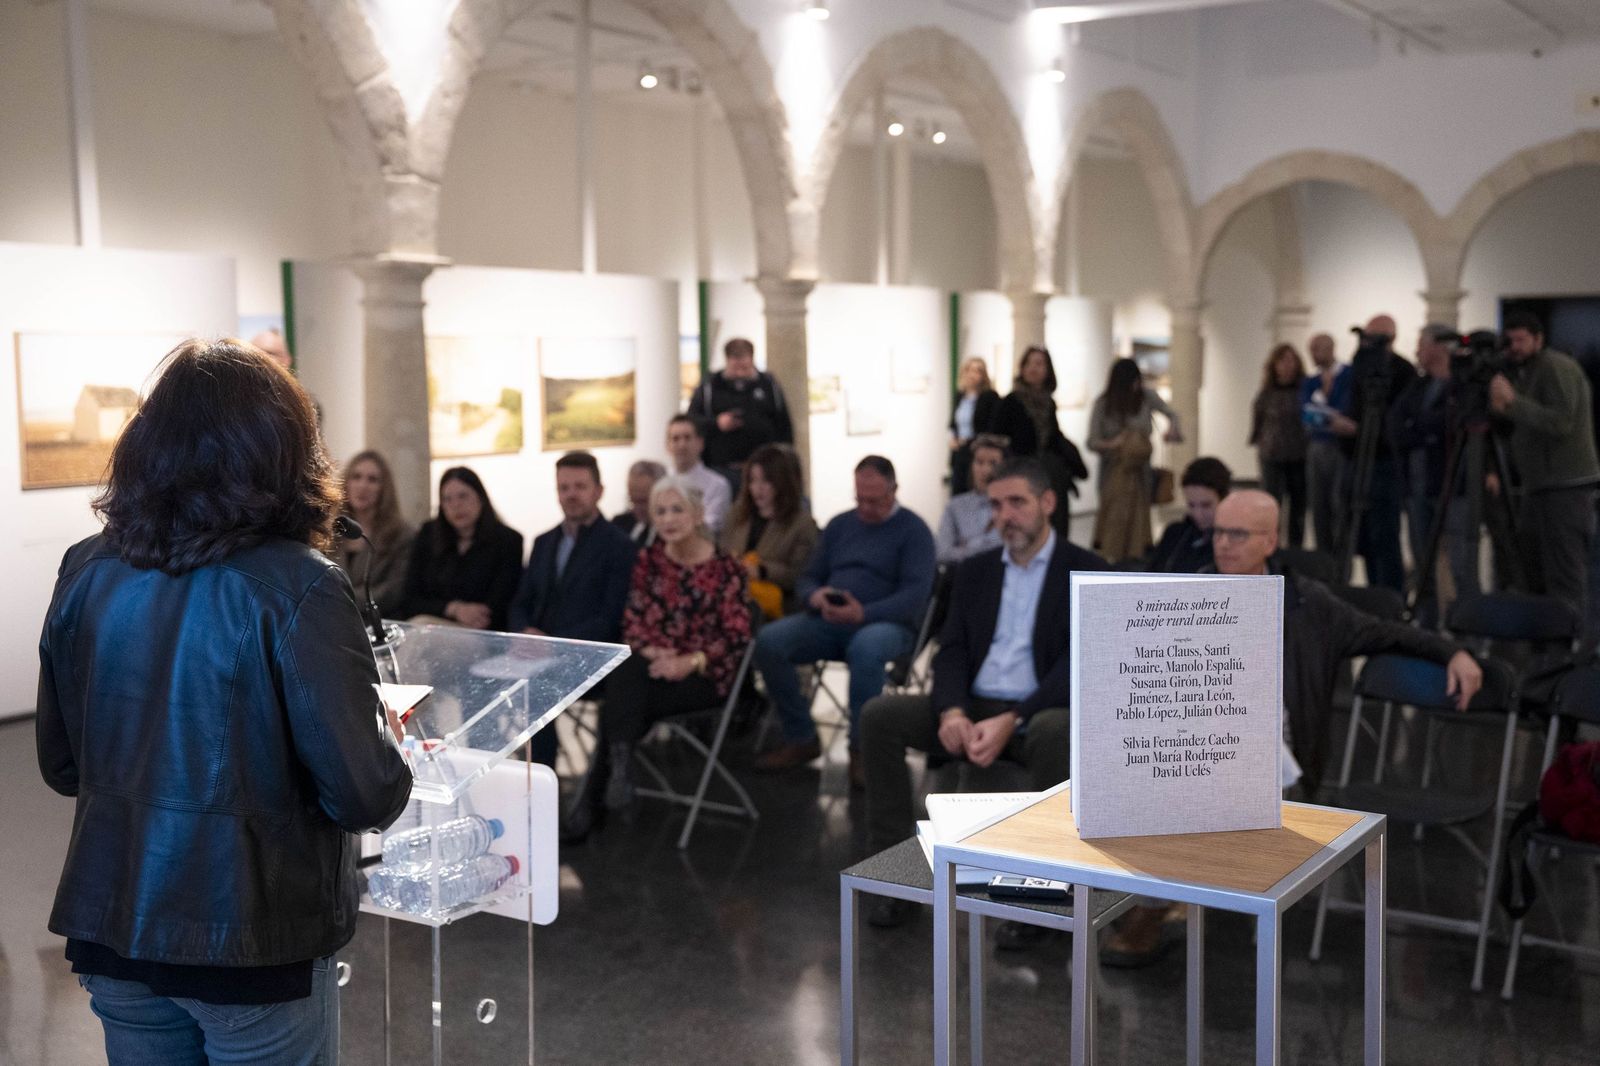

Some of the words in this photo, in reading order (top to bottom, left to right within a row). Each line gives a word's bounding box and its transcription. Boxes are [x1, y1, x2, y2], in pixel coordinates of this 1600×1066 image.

[1136, 600, 1143, 611] 8
[1145, 599, 1189, 611] miradas
[1190, 599, 1219, 611] sobre
[1221, 597, 1230, 610] el
[1126, 615, 1165, 632] paisaje
[1166, 614, 1195, 627] rural
[1196, 613, 1238, 626] andaluz
[1135, 646, 1164, 658] María
[1167, 645, 1202, 657] Clauss,
[1204, 644, 1230, 656] Santi
[1166, 660, 1203, 672] Manolo
[1206, 658, 1245, 674] Espaliú,
[1131, 677, 1167, 689] Susana
[1170, 675, 1201, 688] Girón,
[1204, 674, 1232, 686] David
[1128, 692, 1172, 706] Jiménez,
[1175, 691, 1204, 702] Laura
[1207, 689, 1235, 702] León,
[1116, 707, 1145, 720] Pablo
[1148, 707, 1181, 721] López,
[1183, 705, 1212, 719] Julián
[1215, 704, 1247, 717] Ochoa
[1123, 736, 1150, 749] Silvia
[1153, 735, 1206, 748] Fernández
[1209, 733, 1240, 745] Cacho
[1126, 752, 1149, 766] Juan
[1152, 751, 1182, 763] María
[1185, 749, 1236, 764] Rodríguez
[1153, 766, 1182, 778] David
[1185, 765, 1211, 777] Uclés
